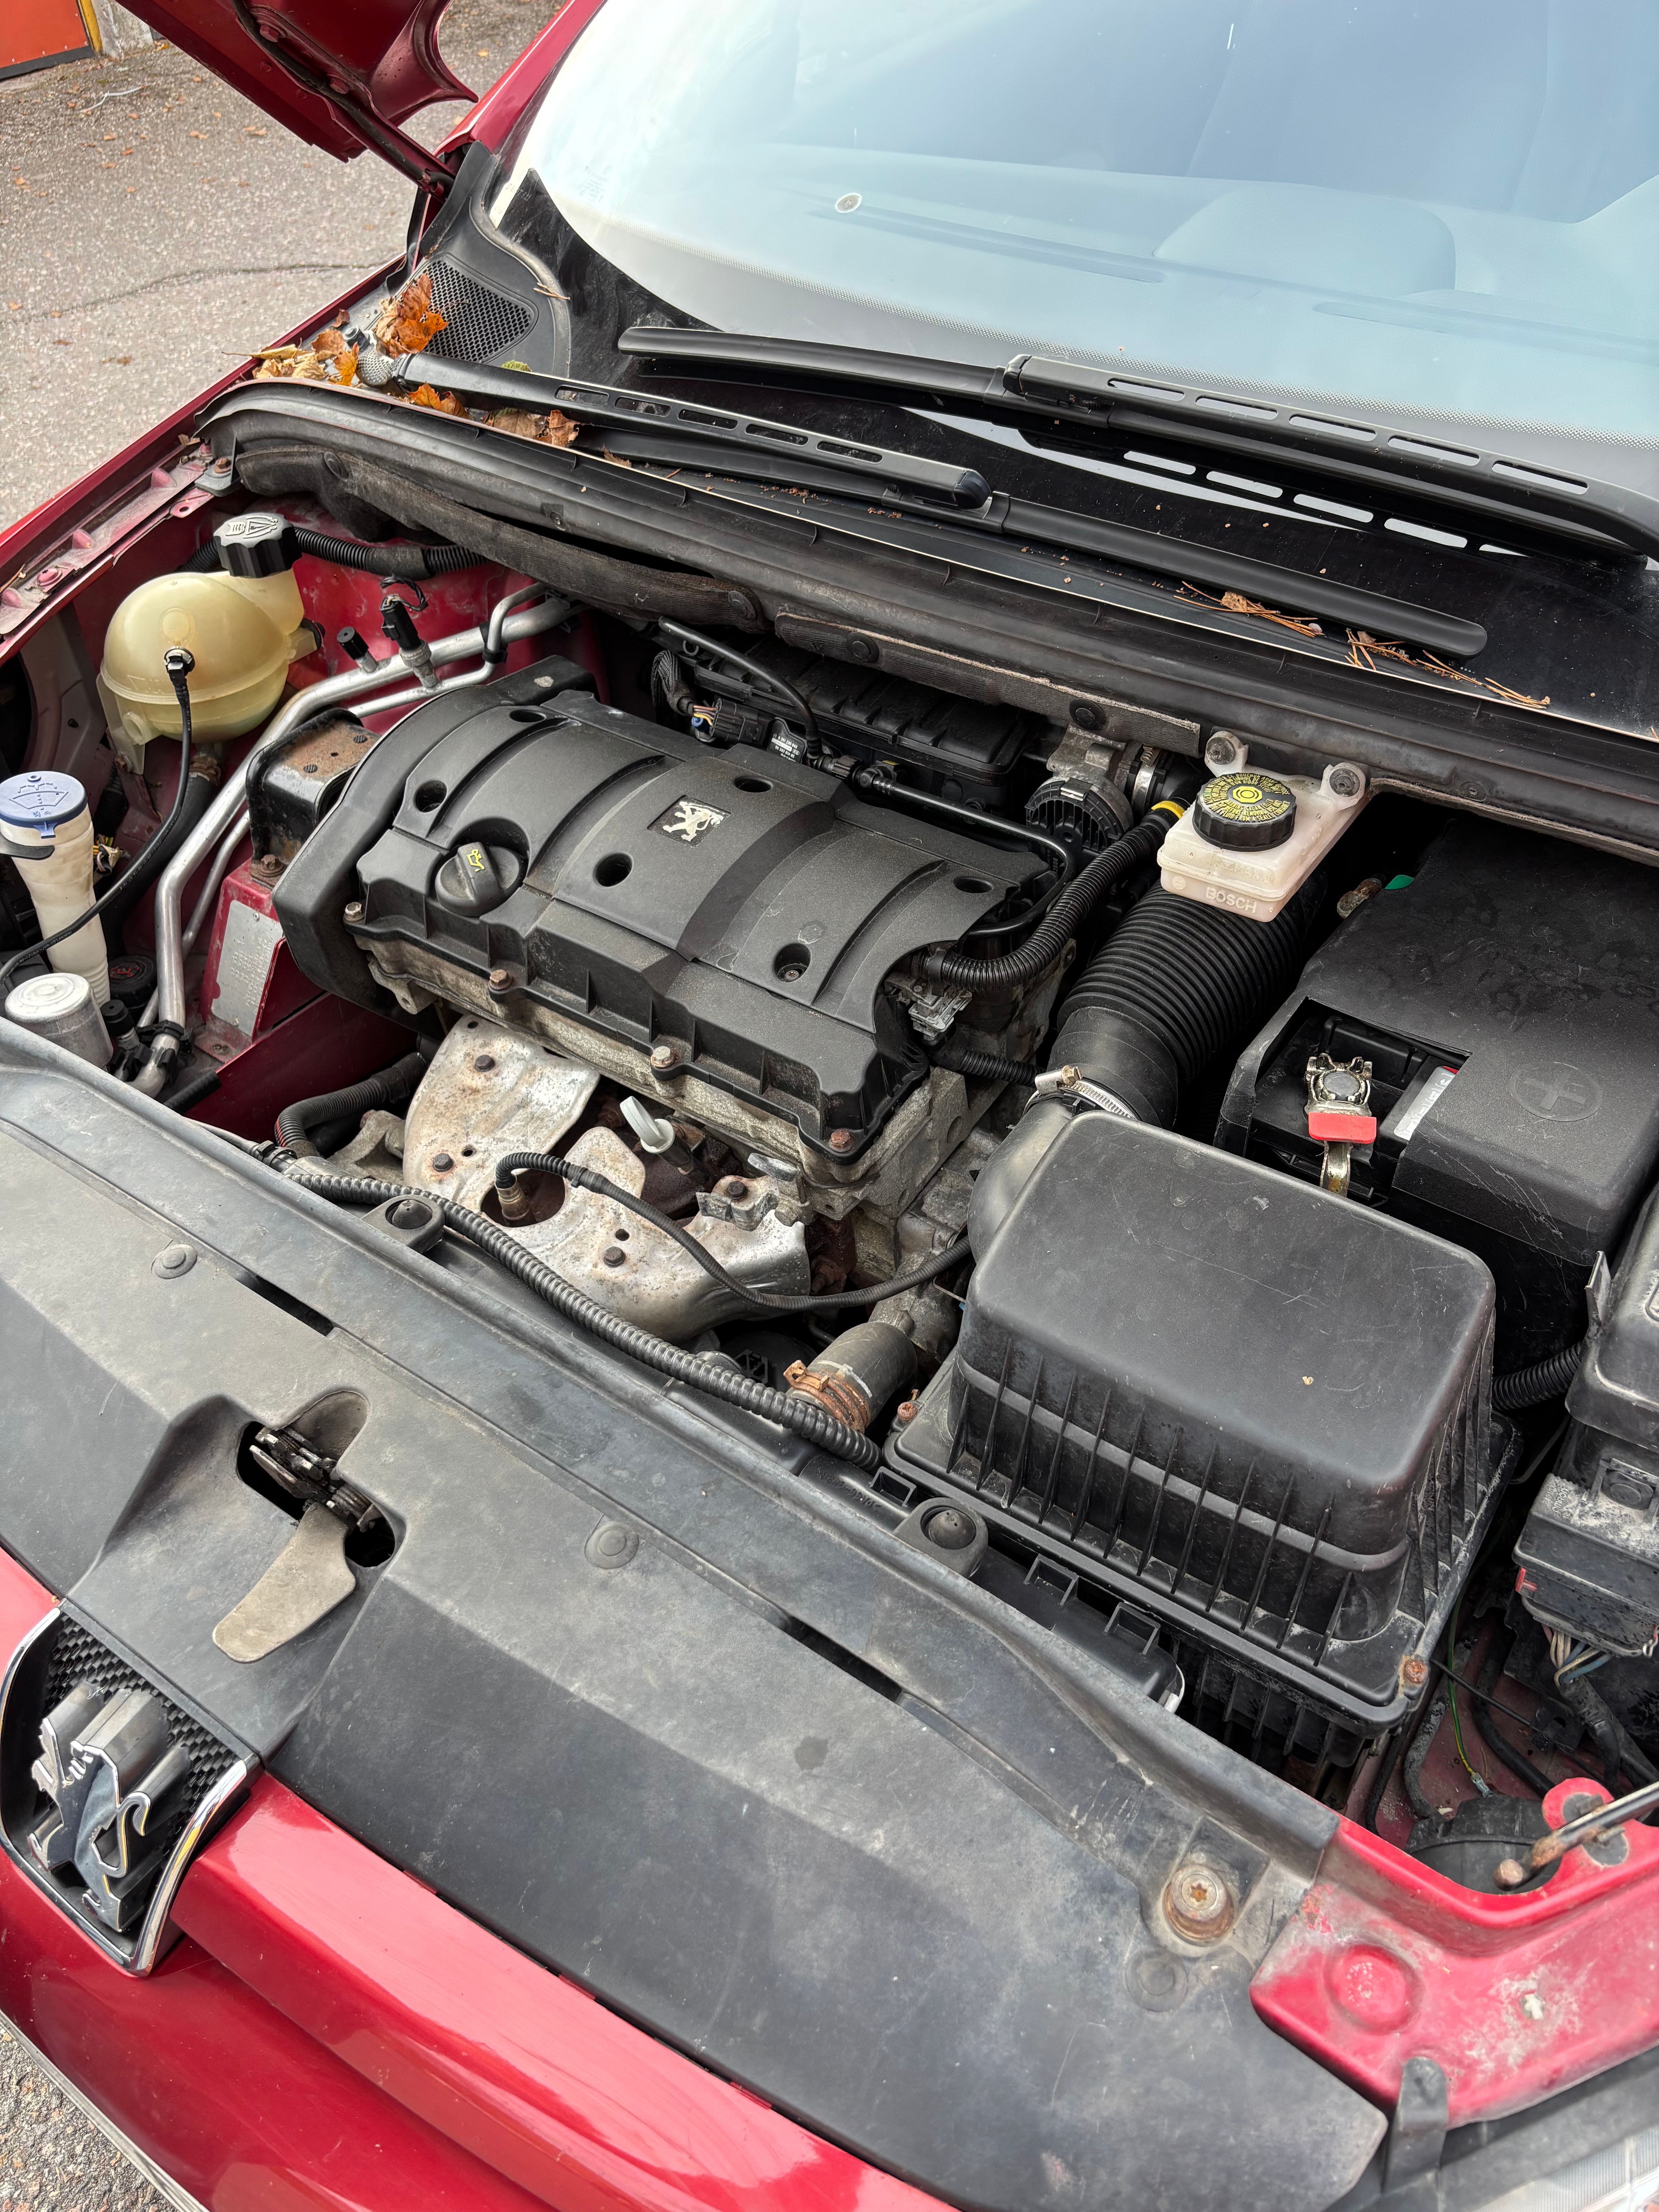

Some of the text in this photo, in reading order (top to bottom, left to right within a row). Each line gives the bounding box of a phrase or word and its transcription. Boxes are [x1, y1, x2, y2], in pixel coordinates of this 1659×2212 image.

[1218, 811, 1236, 819] FLUID
[1221, 805, 1243, 815] BEFORE
[1243, 808, 1268, 817] REMOVING
[1206, 886, 1257, 913] BOSCH
